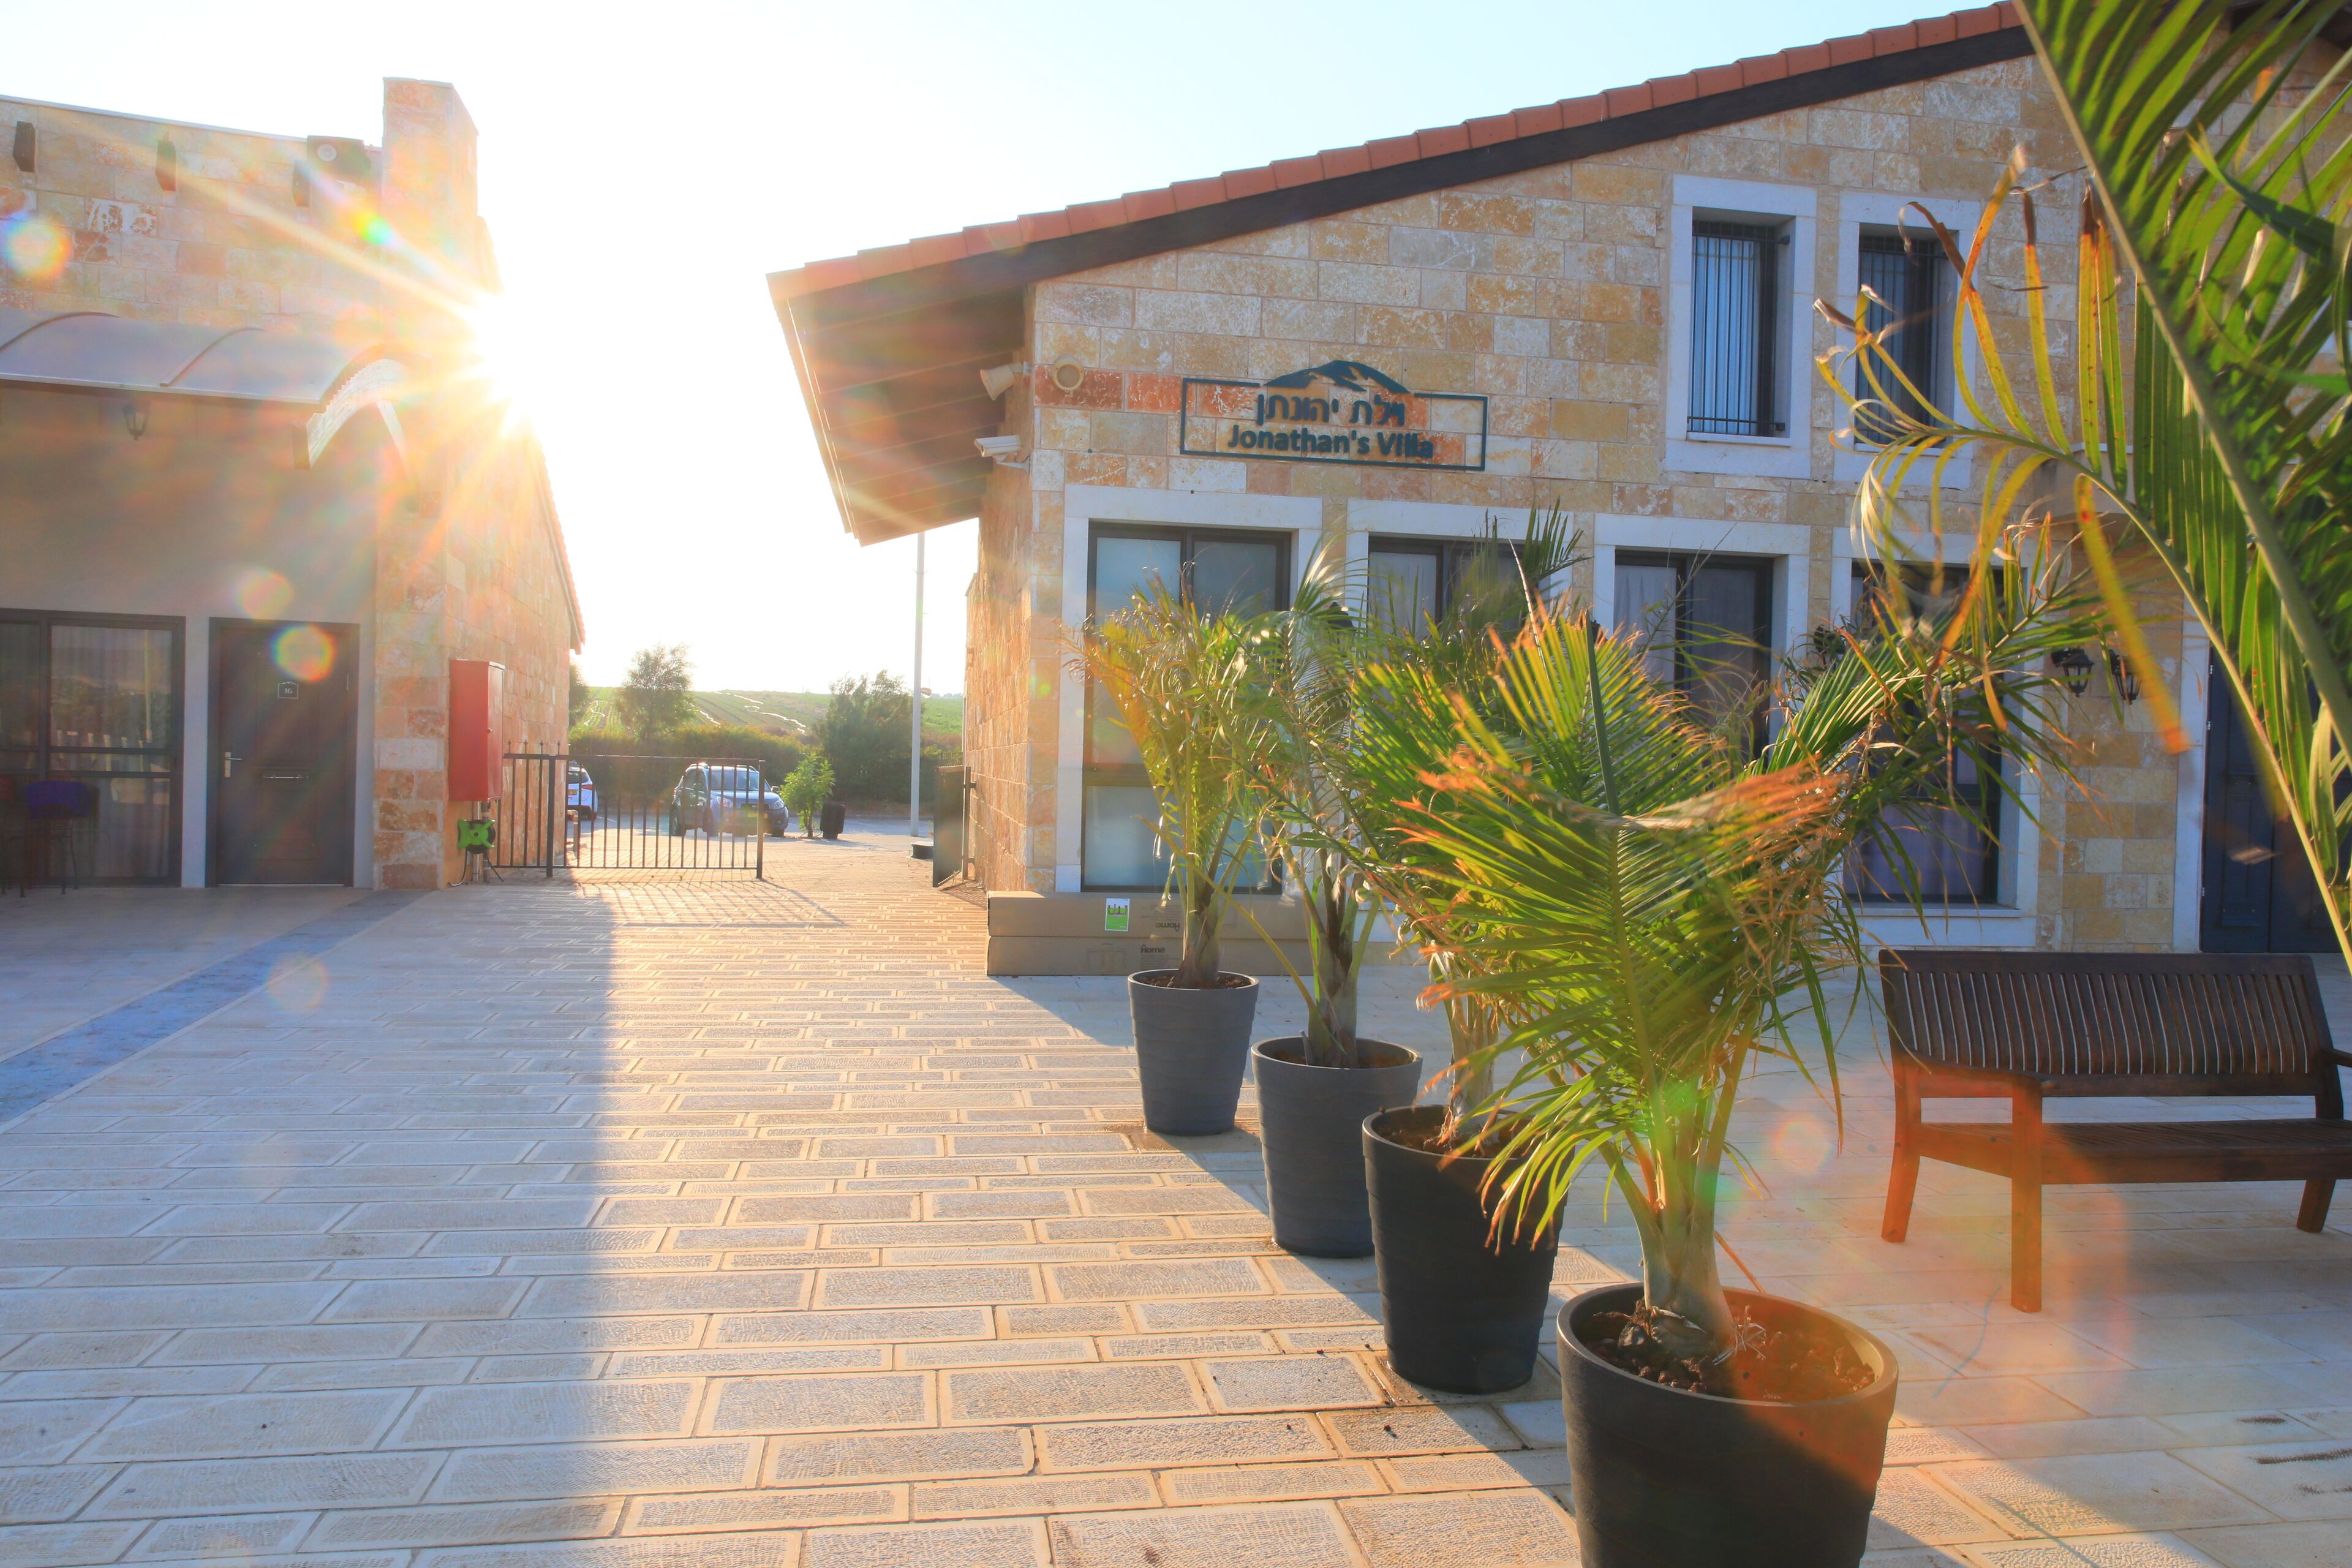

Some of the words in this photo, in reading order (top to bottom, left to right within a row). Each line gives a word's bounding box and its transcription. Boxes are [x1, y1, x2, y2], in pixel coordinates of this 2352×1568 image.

[1257, 393, 1339, 426] יהונתן
[1349, 394, 1405, 426] וילת
[1227, 424, 1370, 454] Jonathan's
[1377, 432, 1434, 459] Villa
